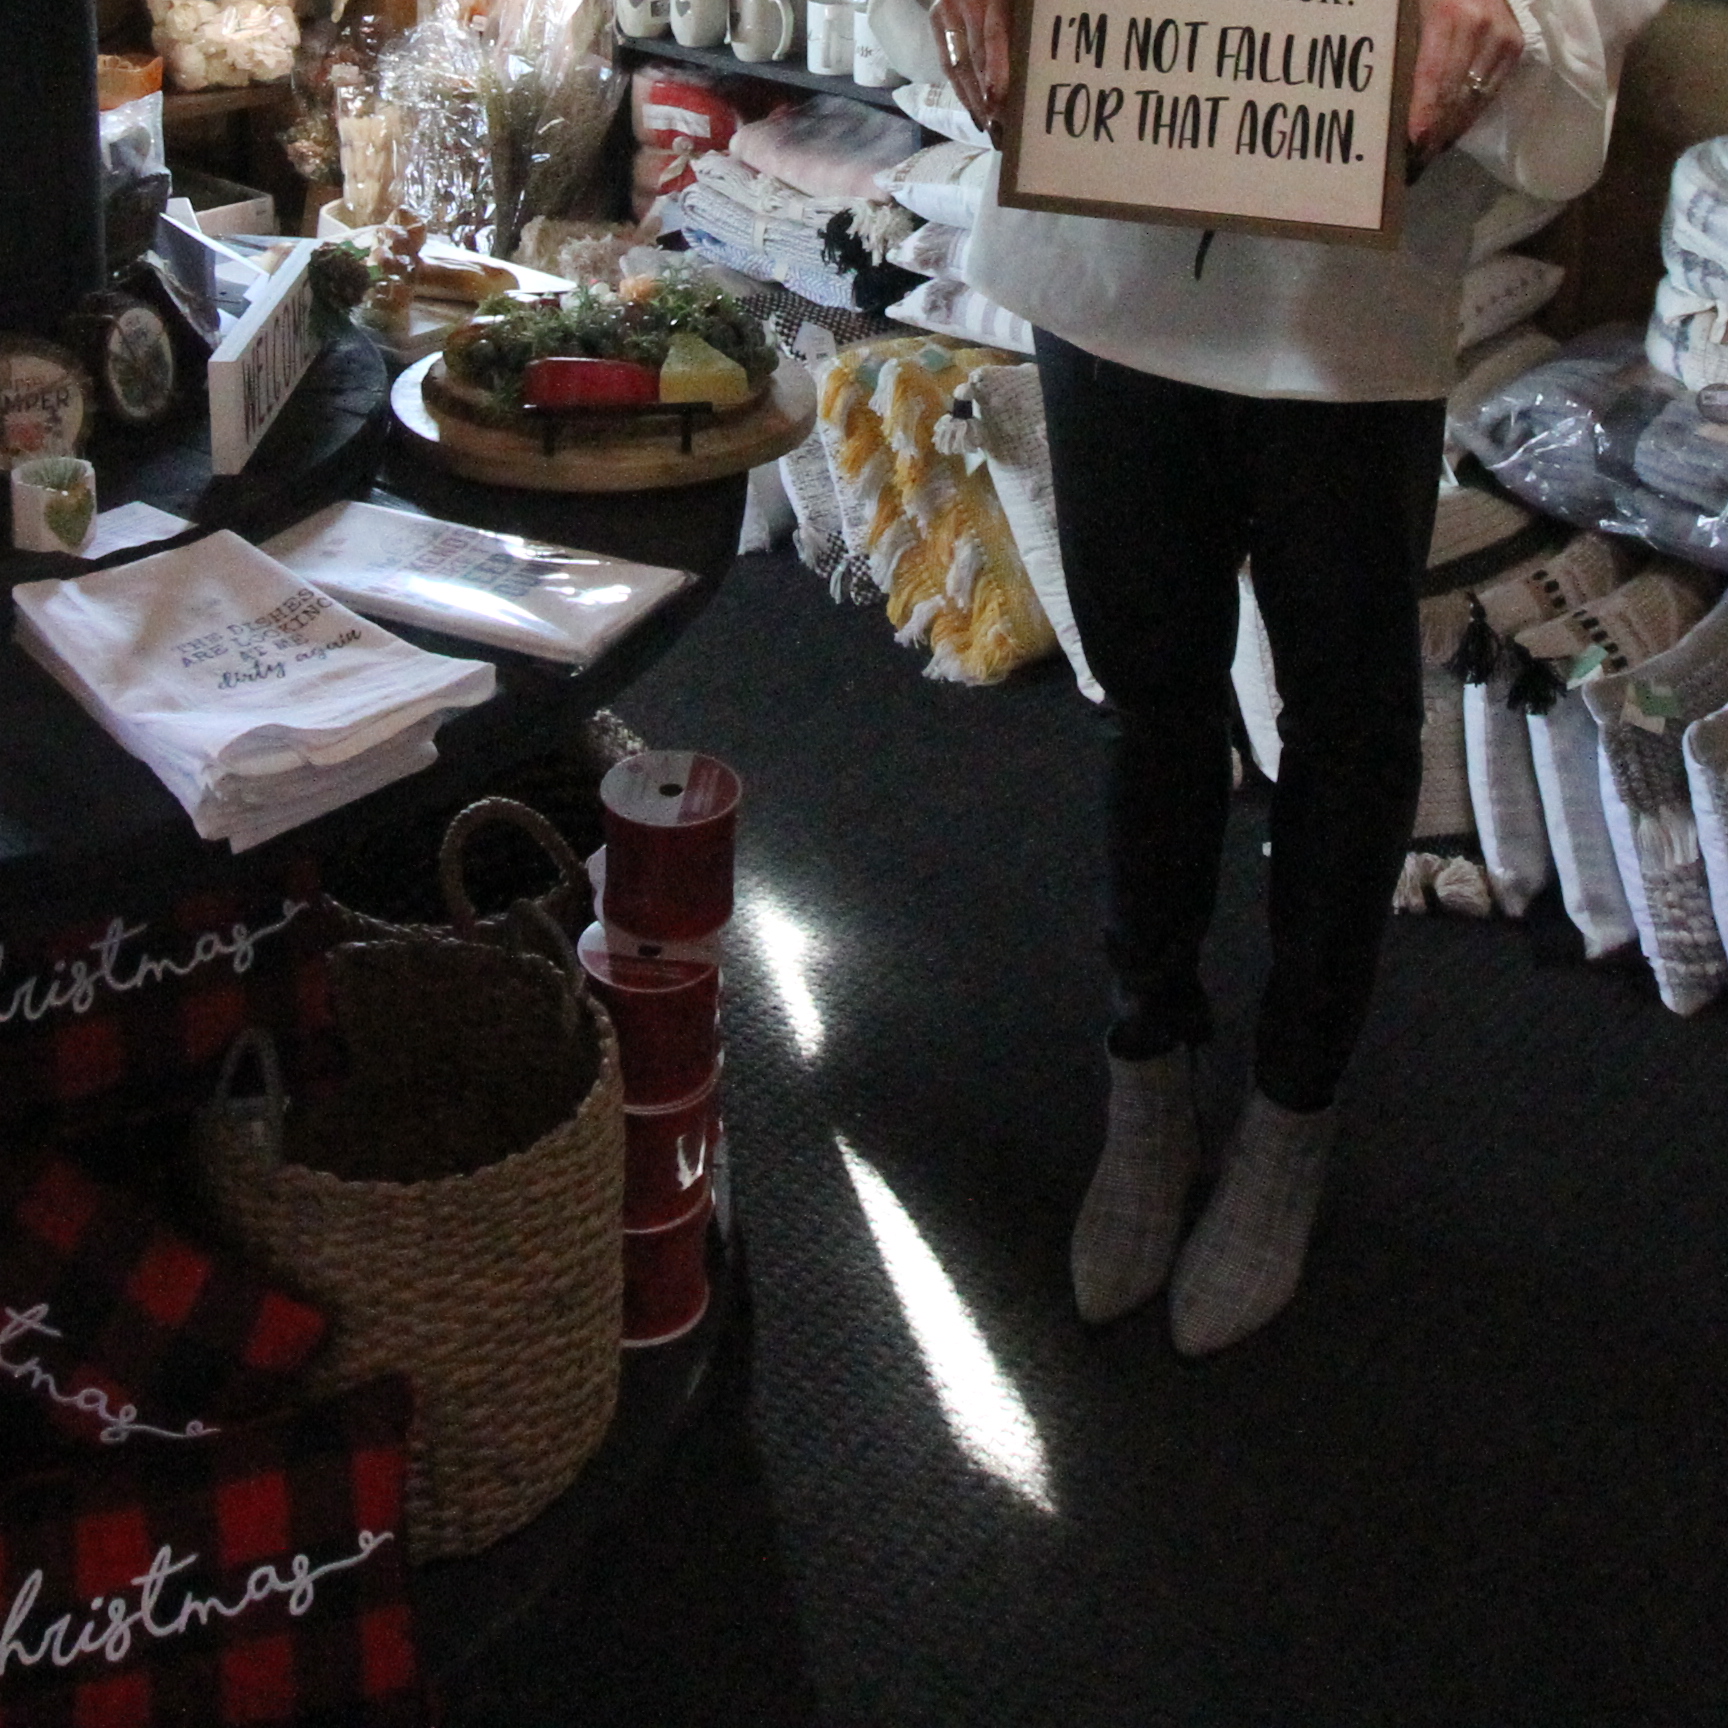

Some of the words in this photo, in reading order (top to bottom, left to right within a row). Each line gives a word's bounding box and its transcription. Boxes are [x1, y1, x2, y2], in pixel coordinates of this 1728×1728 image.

[1051, 12, 1109, 69] I'M
[1125, 17, 1210, 73] NOT
[1217, 26, 1374, 93] FALLING
[1045, 83, 1124, 143] FOR
[1135, 90, 1230, 149] THAT
[1236, 99, 1365, 165] AGAIN.
[172, 632, 223, 653] THE
[227, 587, 315, 636] DISHES
[181, 644, 229, 668] ARE
[231, 596, 333, 647] LOOKING
[239, 645, 268, 662] AT
[275, 633, 308, 650] ME
[218, 659, 286, 690] dirty
[295, 629, 362, 662] again
